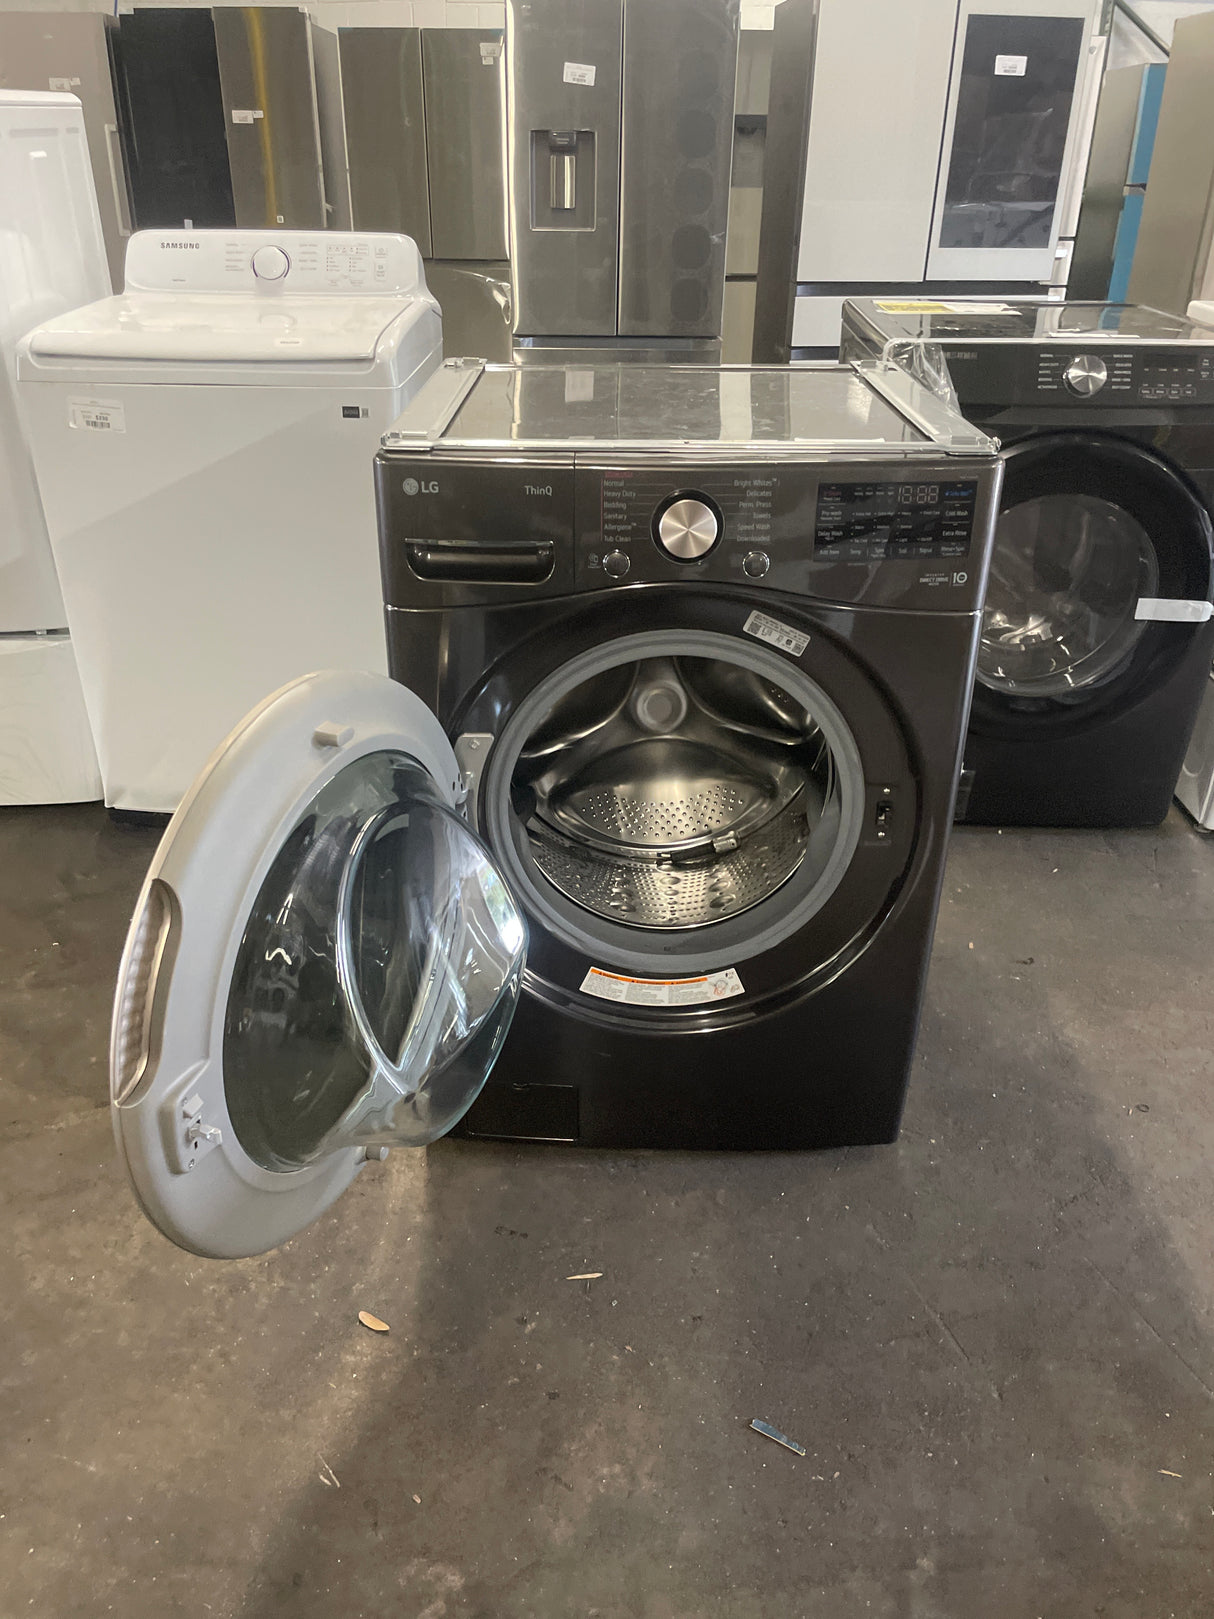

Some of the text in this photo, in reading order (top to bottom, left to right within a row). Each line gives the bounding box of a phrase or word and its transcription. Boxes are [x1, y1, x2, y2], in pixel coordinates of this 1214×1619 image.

[421, 481, 439, 493] LG
[604, 479, 624, 487] Normal
[523, 485, 552, 496] ThinQ
[604, 490, 636, 499] Heavy Duty
